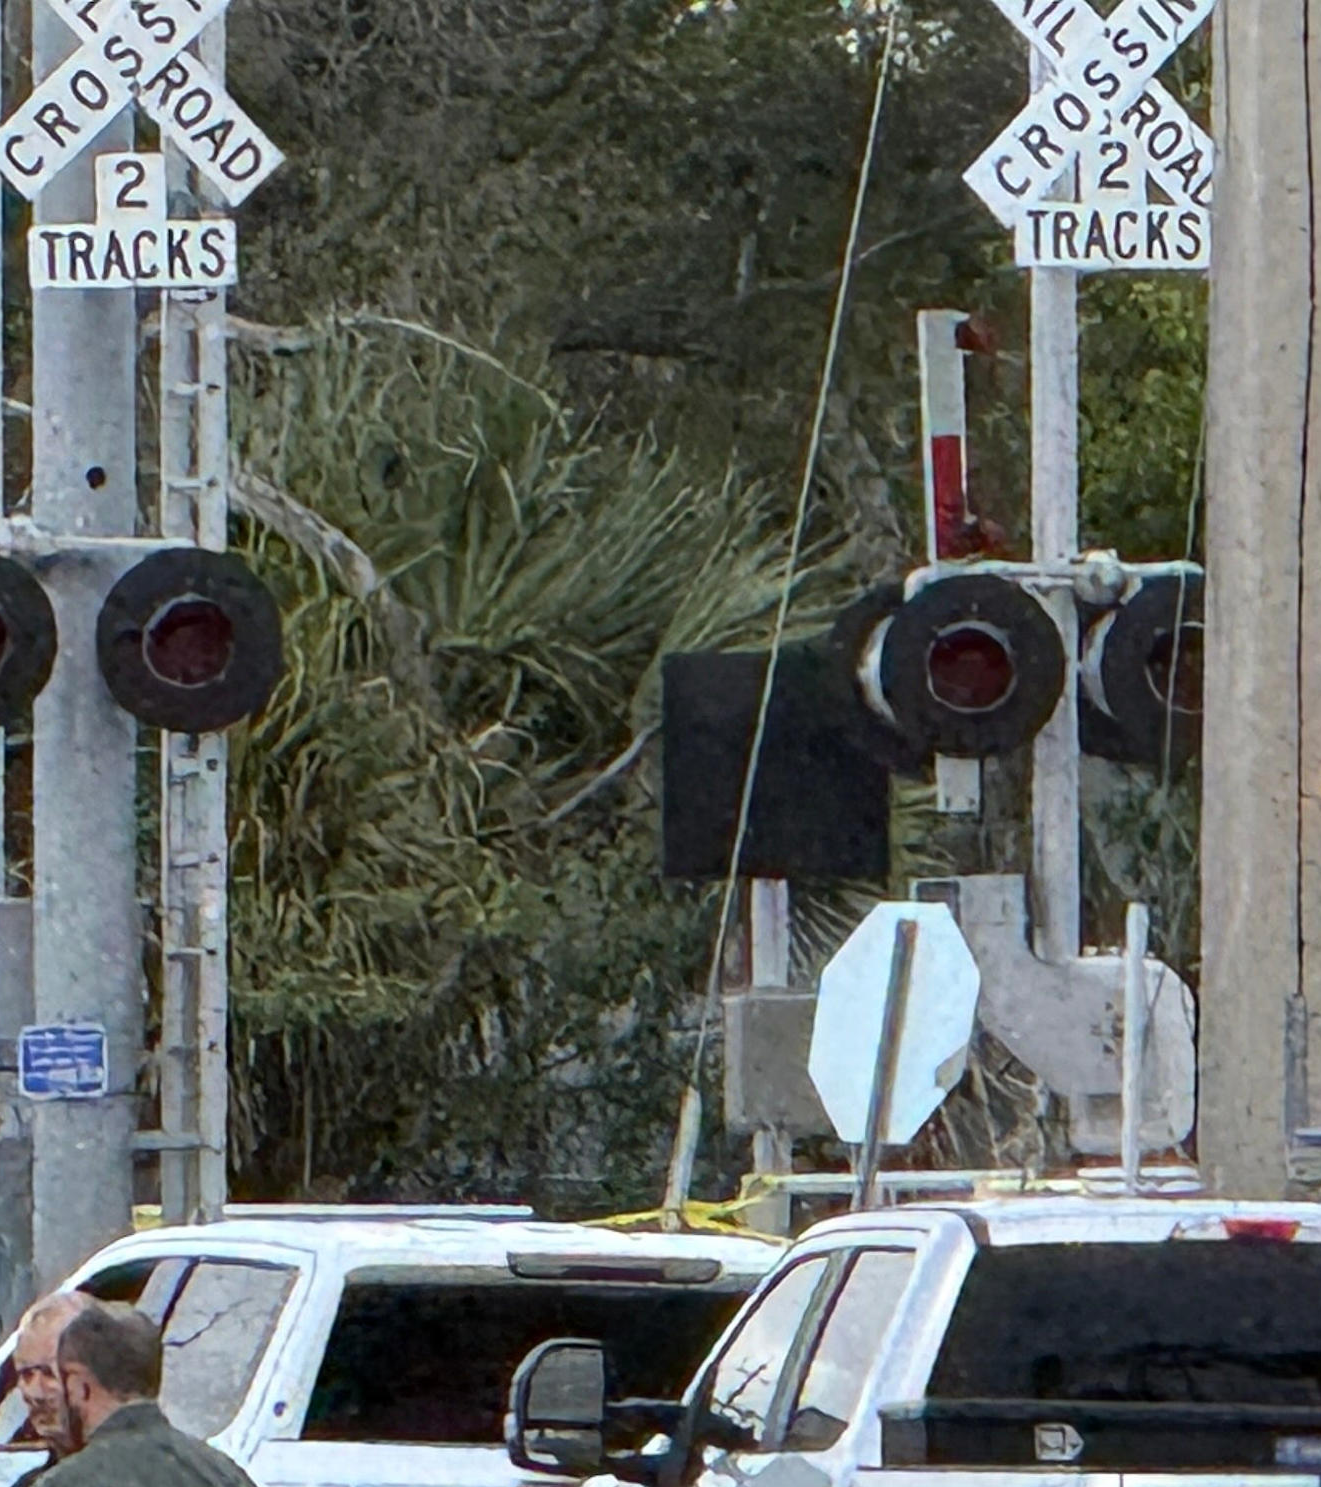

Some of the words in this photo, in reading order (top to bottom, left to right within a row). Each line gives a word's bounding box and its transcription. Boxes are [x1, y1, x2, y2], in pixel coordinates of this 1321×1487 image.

[5, 0, 202, 177] CROSS
[145, 55, 262, 182] ROAD
[115, 160, 148, 209] 2
[1098, 142, 1130, 189] 2
[39, 228, 225, 281] TRACKS
[1026, 210, 1202, 261] TRACKS
